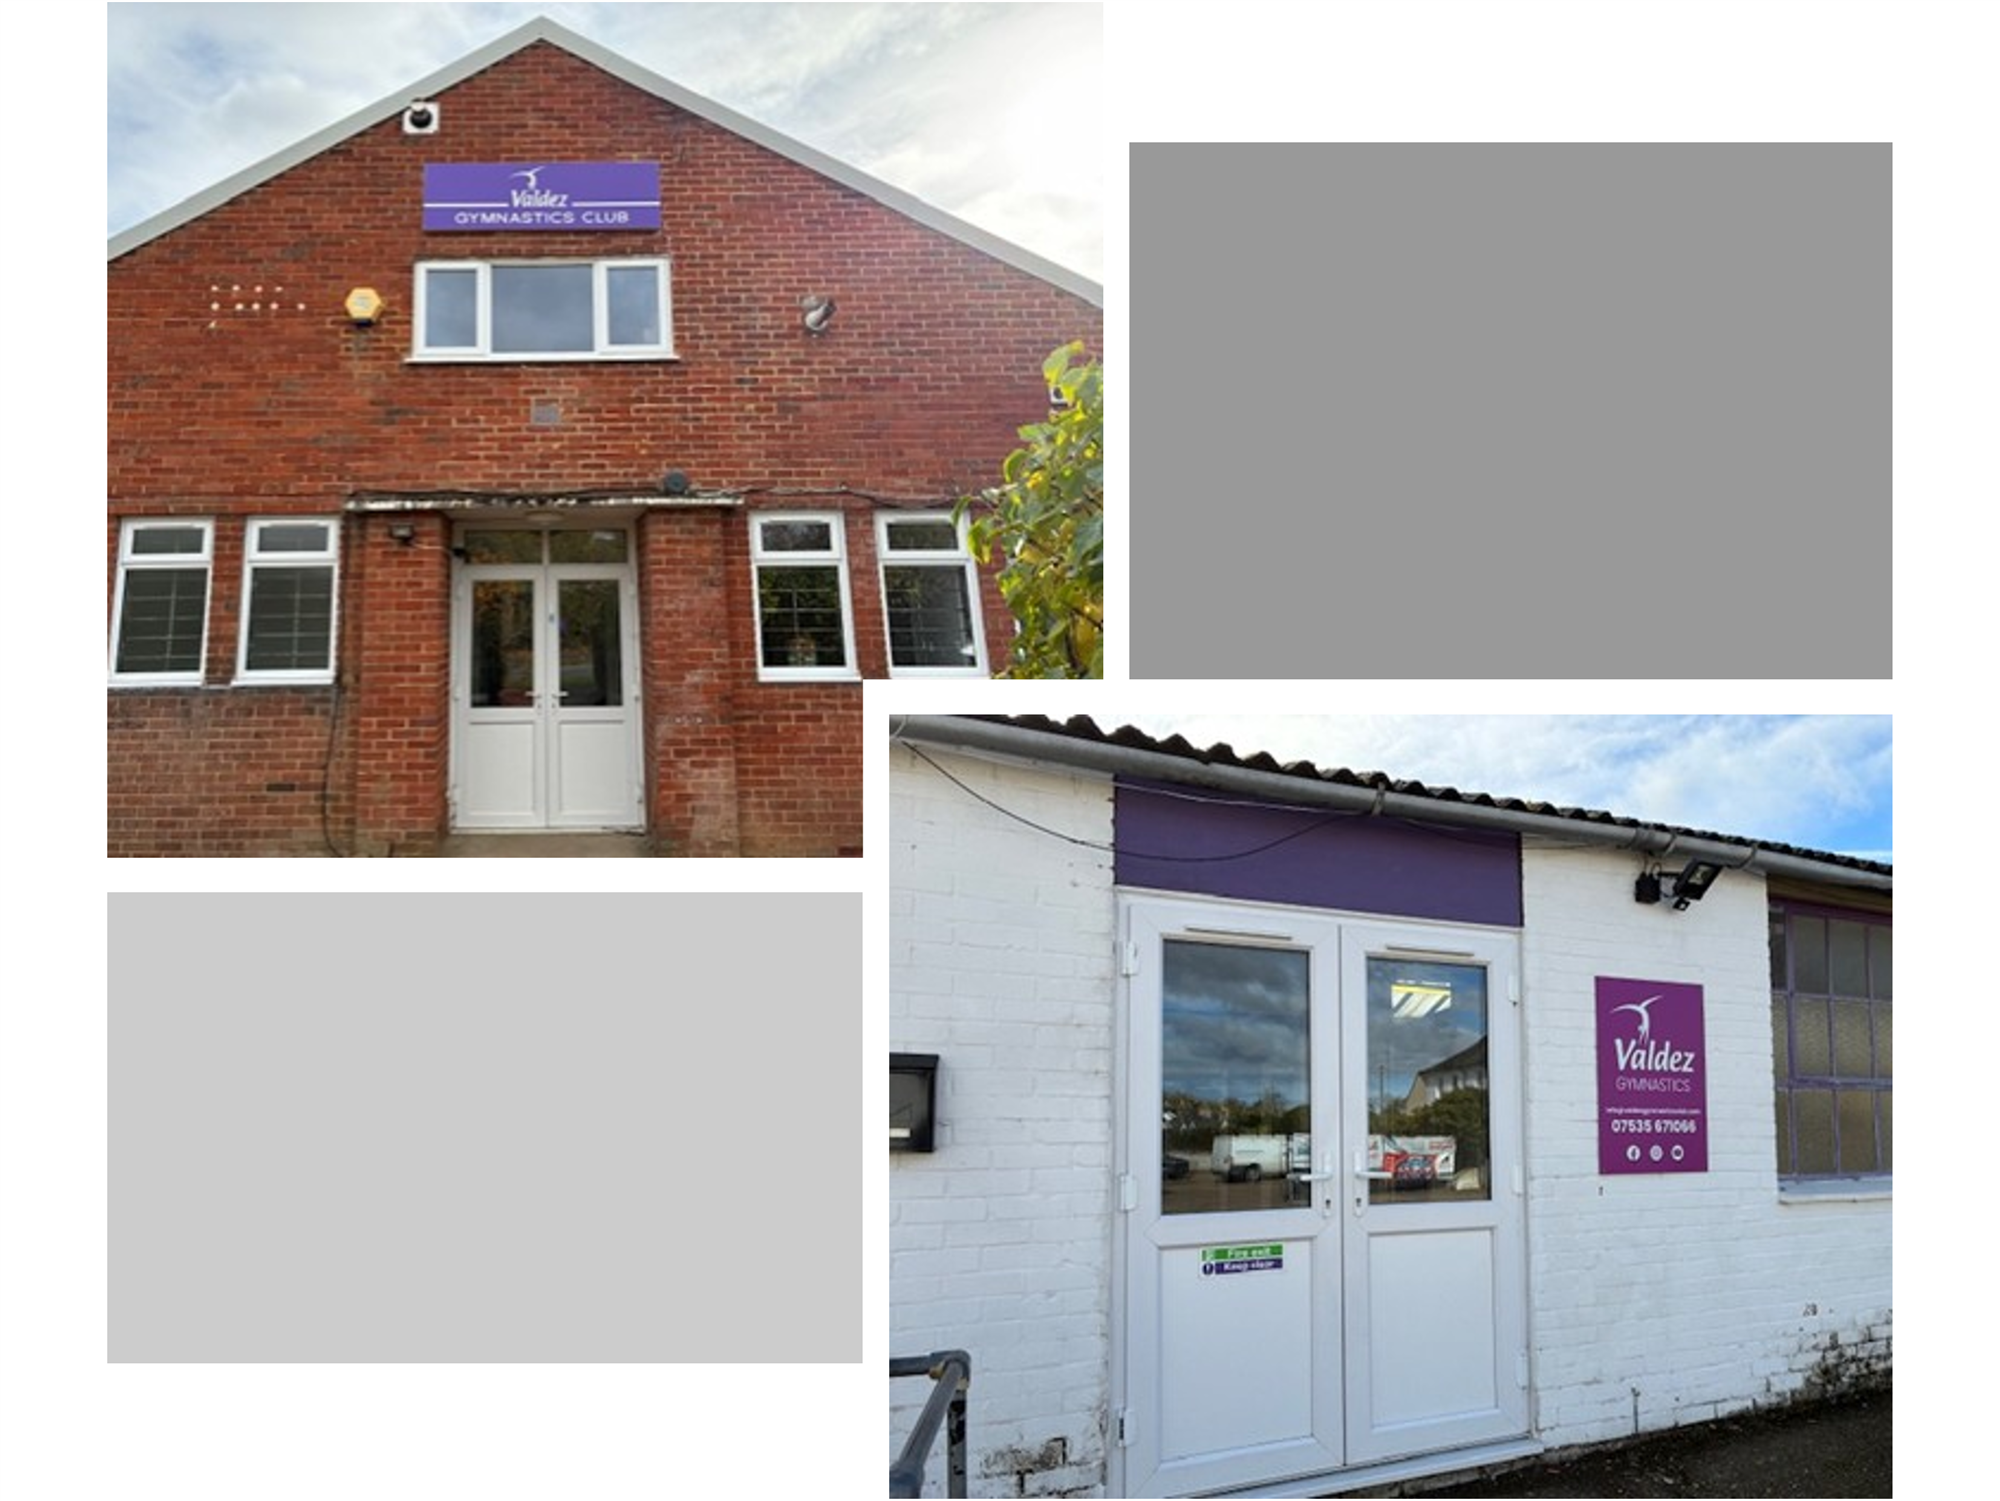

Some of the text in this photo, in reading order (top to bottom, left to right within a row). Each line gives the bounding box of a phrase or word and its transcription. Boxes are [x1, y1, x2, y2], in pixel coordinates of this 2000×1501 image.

[511, 190, 568, 208] Valdez
[454, 210, 629, 224] GYMNASTICS CLUB
[1614, 1038, 1695, 1072] Valdez
[1615, 1077, 1690, 1093] GYMNASTICS
[1611, 1119, 1697, 1133] 07535 671066
